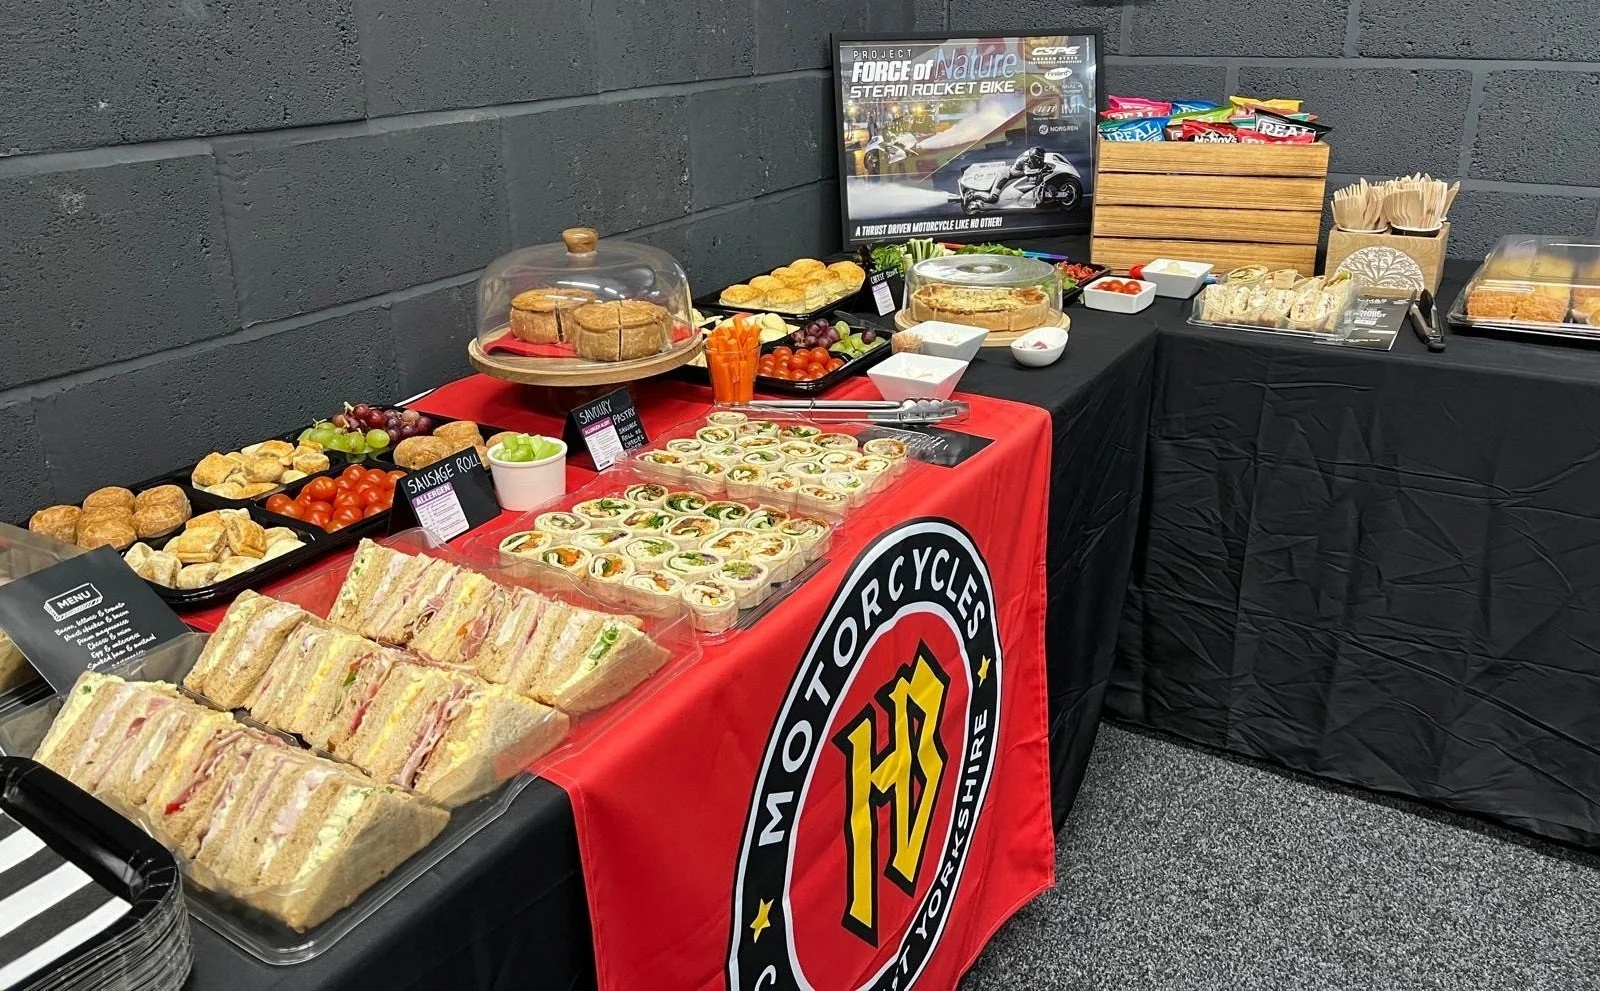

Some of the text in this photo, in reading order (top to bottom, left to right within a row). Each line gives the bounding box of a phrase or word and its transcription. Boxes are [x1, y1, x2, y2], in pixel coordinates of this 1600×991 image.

[853, 49, 912, 60] PROJECT
[852, 46, 1018, 83] FORCE of Nature
[850, 80, 1016, 99] STEAM ROCKET BIKE
[1112, 122, 1158, 141] REAL
[855, 216, 1003, 236] A THRUST DRIVEN MOTORCYCLE LIKE NO OTHER!
[579, 399, 612, 425] SAVOURY
[612, 406, 636, 426] PASTRY
[407, 453, 482, 494] SAUSAGE ROLL
[415, 483, 451, 506] ALLERGEN
[56, 590, 91, 609] MENU
[82, 620, 105, 633] chicken
[87, 637, 109, 651] Cheese
[87, 653, 113, 671] Smoked
[90, 650, 104, 659] Egg
[758, 546, 985, 846] MOTORCYCLES
[915, 709, 988, 940] YORKSHIRE
